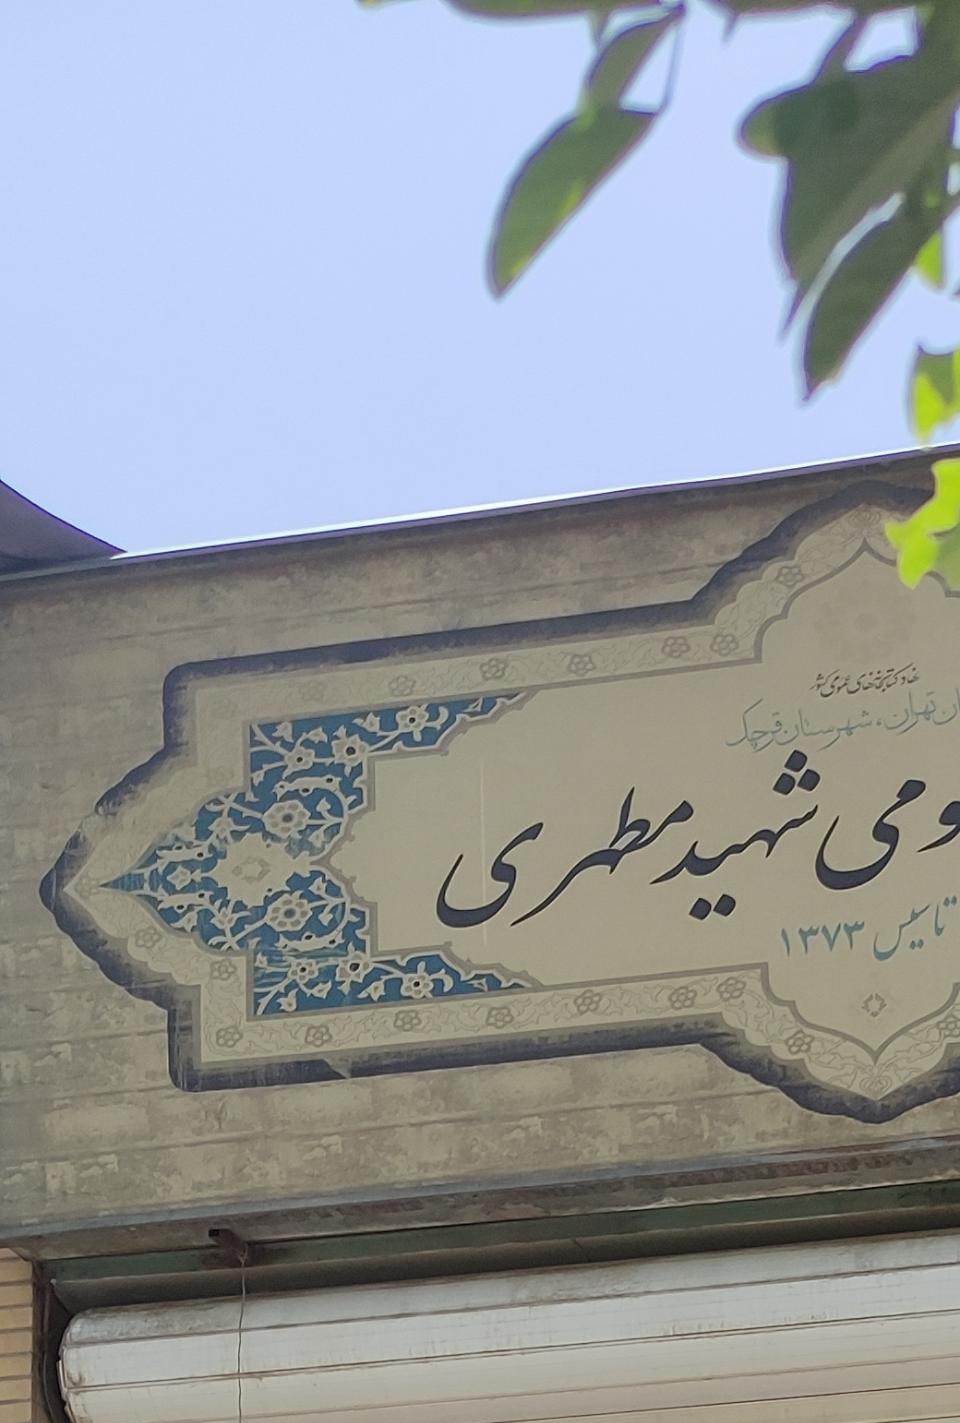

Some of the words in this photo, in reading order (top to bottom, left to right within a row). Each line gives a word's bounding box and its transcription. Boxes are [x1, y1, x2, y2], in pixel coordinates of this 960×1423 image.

[809, 668, 840, 691] کشور
[725, 698, 782, 752] قرچک
[774, 708, 873, 751] شهرستان
[436, 786, 695, 928] مطهری
[649, 749, 821, 921] شهید
[780, 920, 865, 957] ۱۳۷۳
